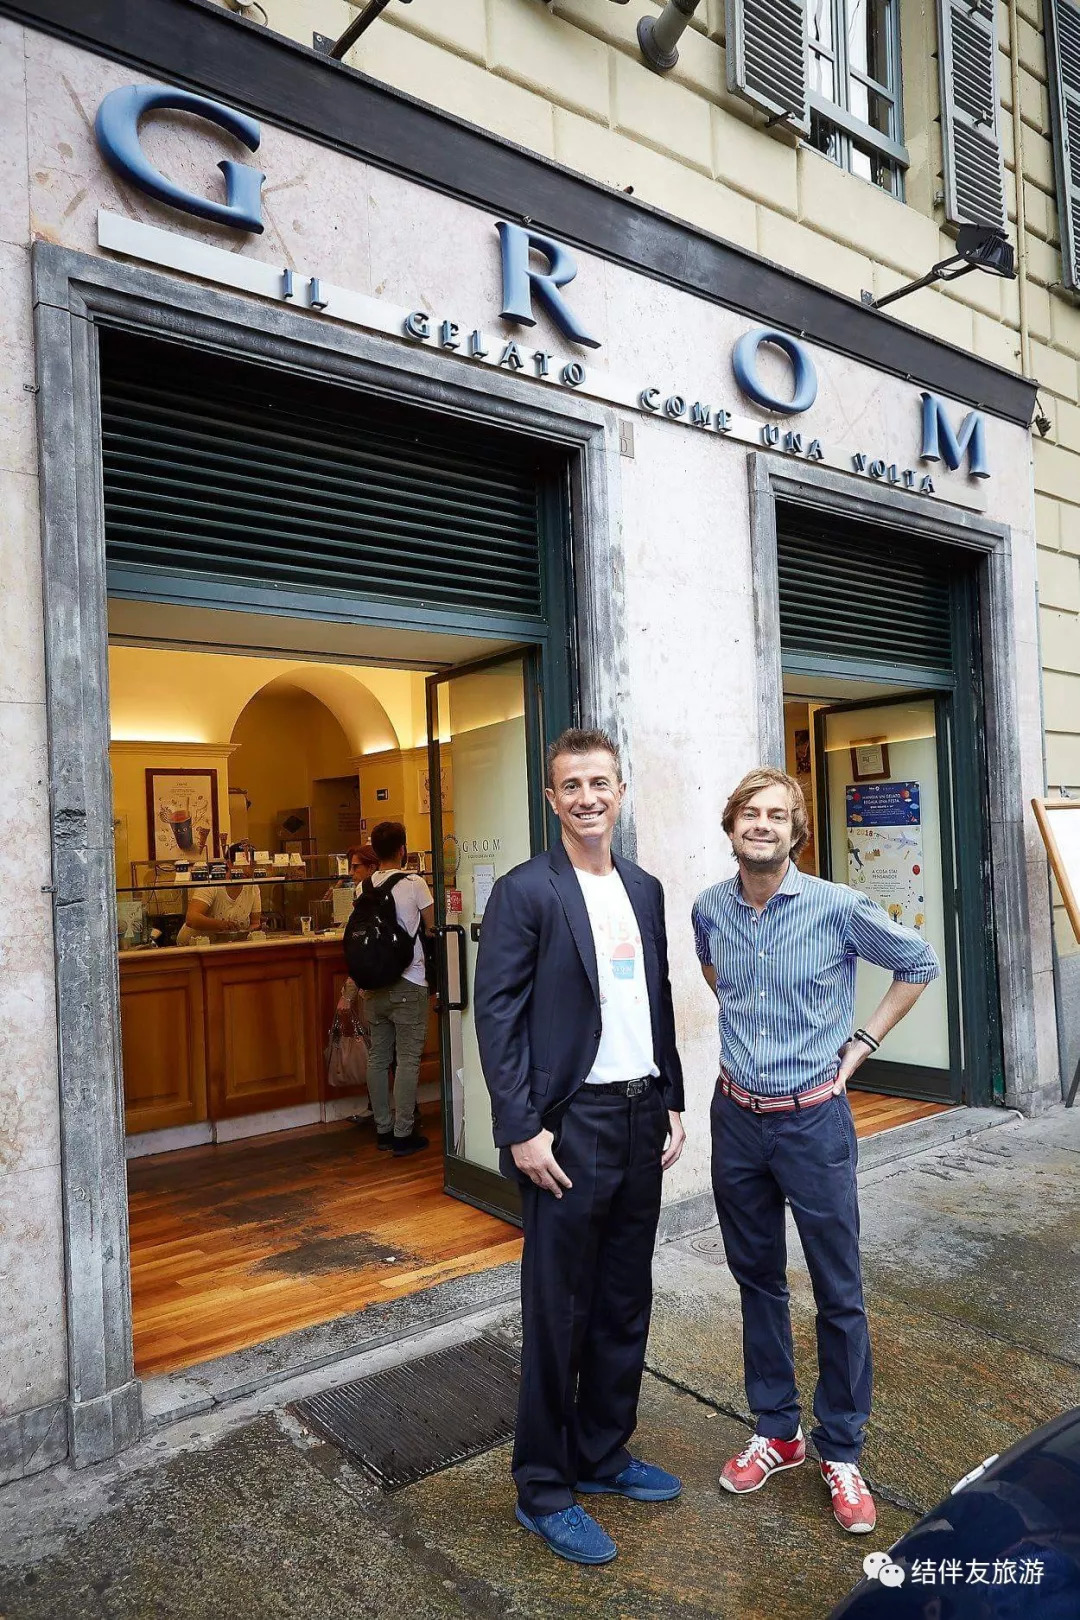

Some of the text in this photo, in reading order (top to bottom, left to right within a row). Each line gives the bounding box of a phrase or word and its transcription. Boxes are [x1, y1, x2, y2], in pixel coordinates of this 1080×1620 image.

[95, 83, 990, 479] GROM
[281, 267, 936, 494] IL GELATO COME UNA VOLTA
[462, 839, 501, 852] GROM
[856, 829, 873, 837] 2018
